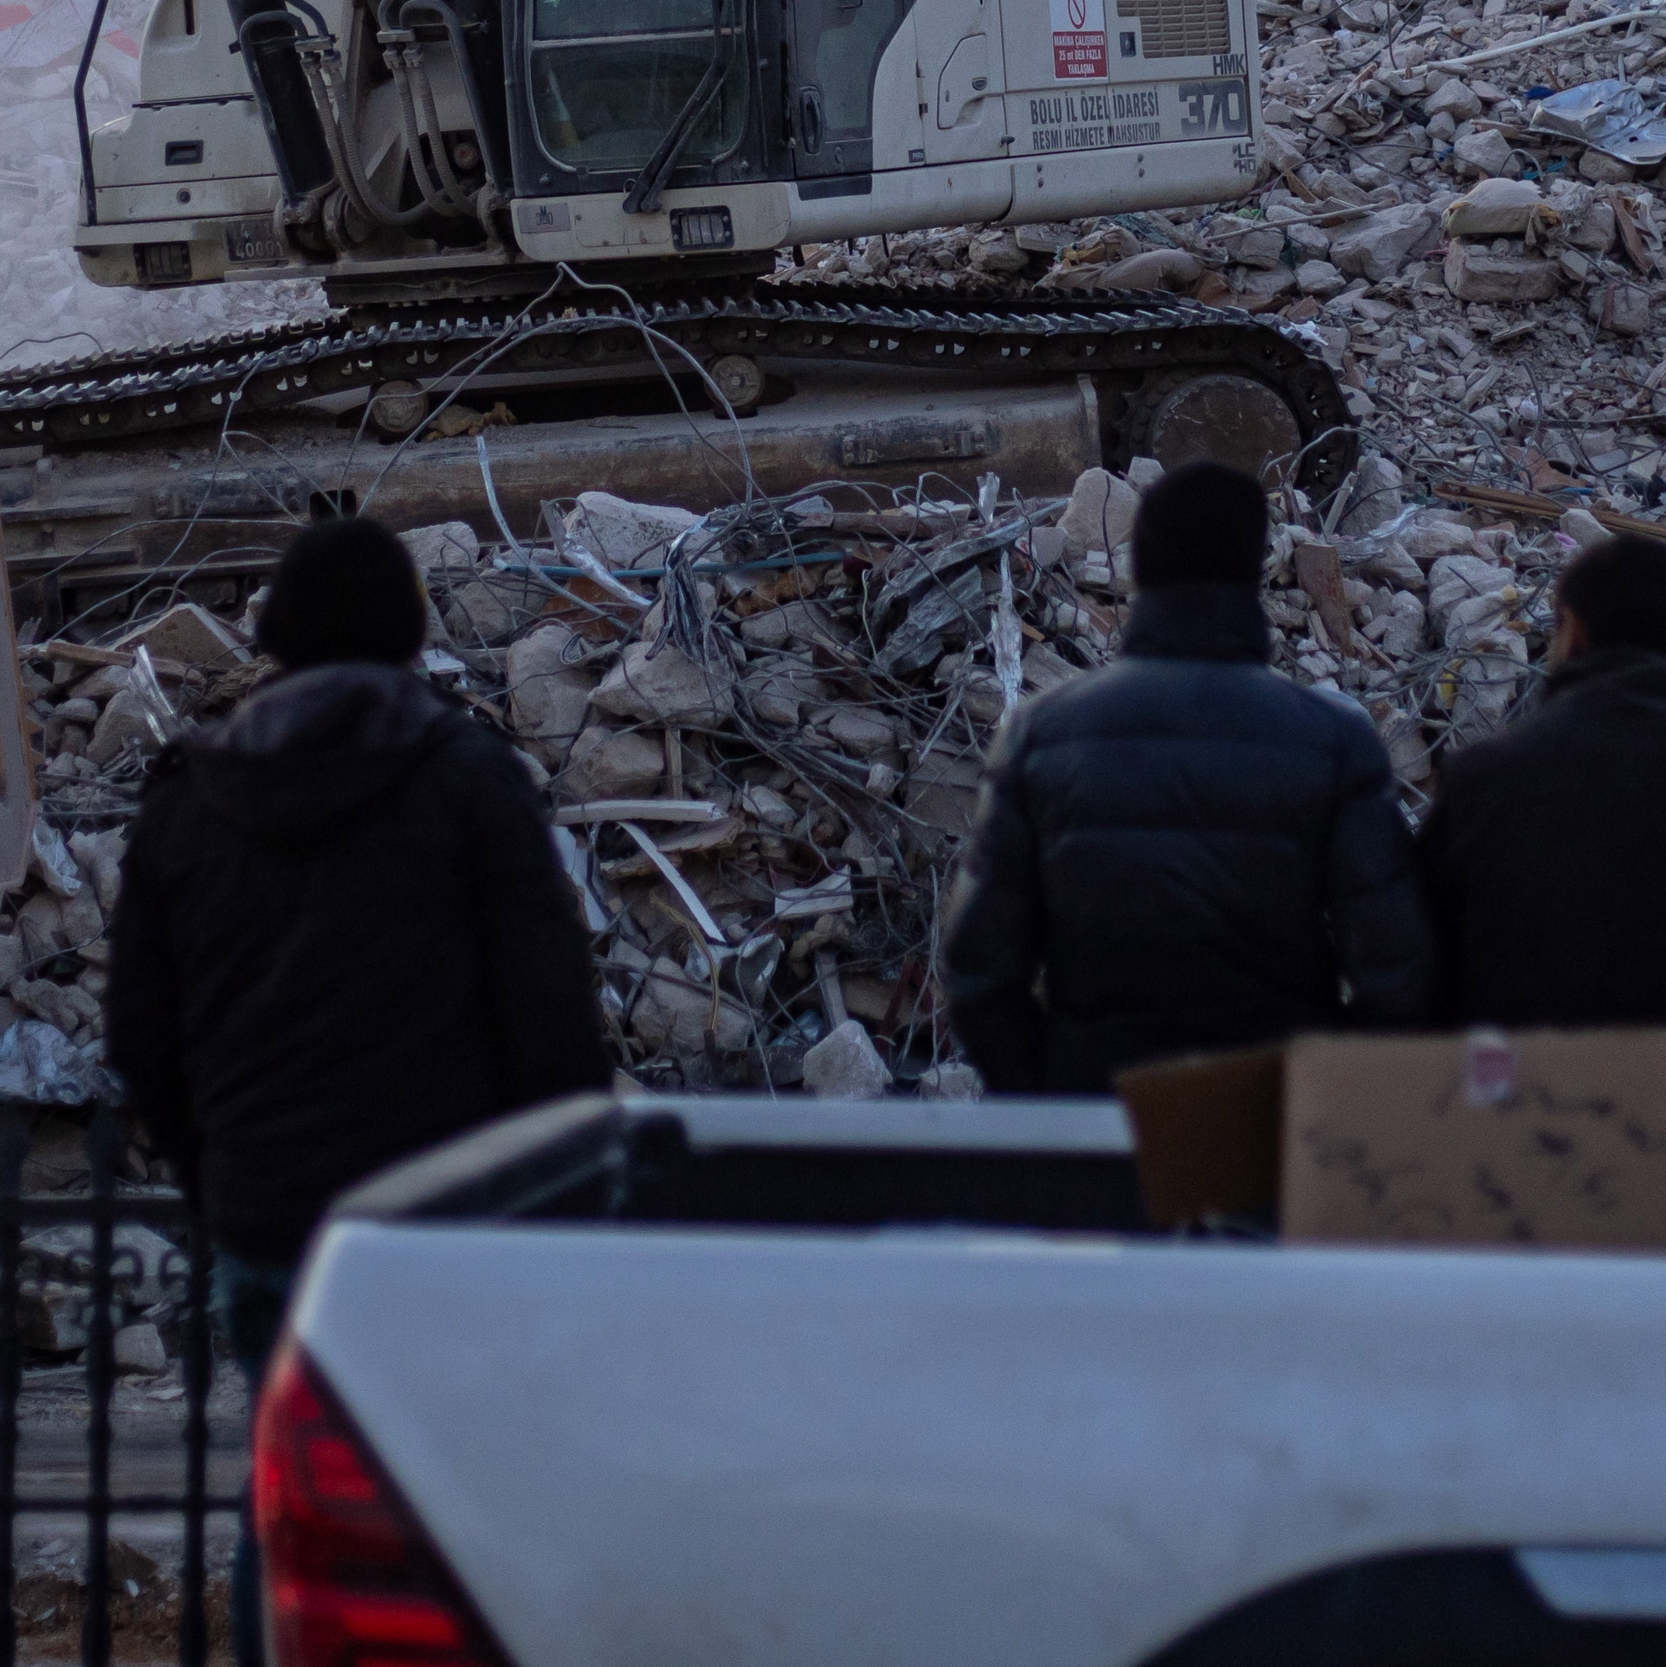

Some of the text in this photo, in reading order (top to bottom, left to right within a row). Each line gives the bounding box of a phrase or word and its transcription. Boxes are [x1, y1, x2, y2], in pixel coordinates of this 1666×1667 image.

[1212, 54, 1246, 76] HMK
[1030, 86, 1159, 125] BOLU İL ÖZEL İDARESİ
[1178, 80, 1247, 135] 370
[1064, 123, 1105, 148] HİZMETE
[1107, 121, 1161, 145] MAHSUSTUR
[1237, 142, 1256, 159] LC
